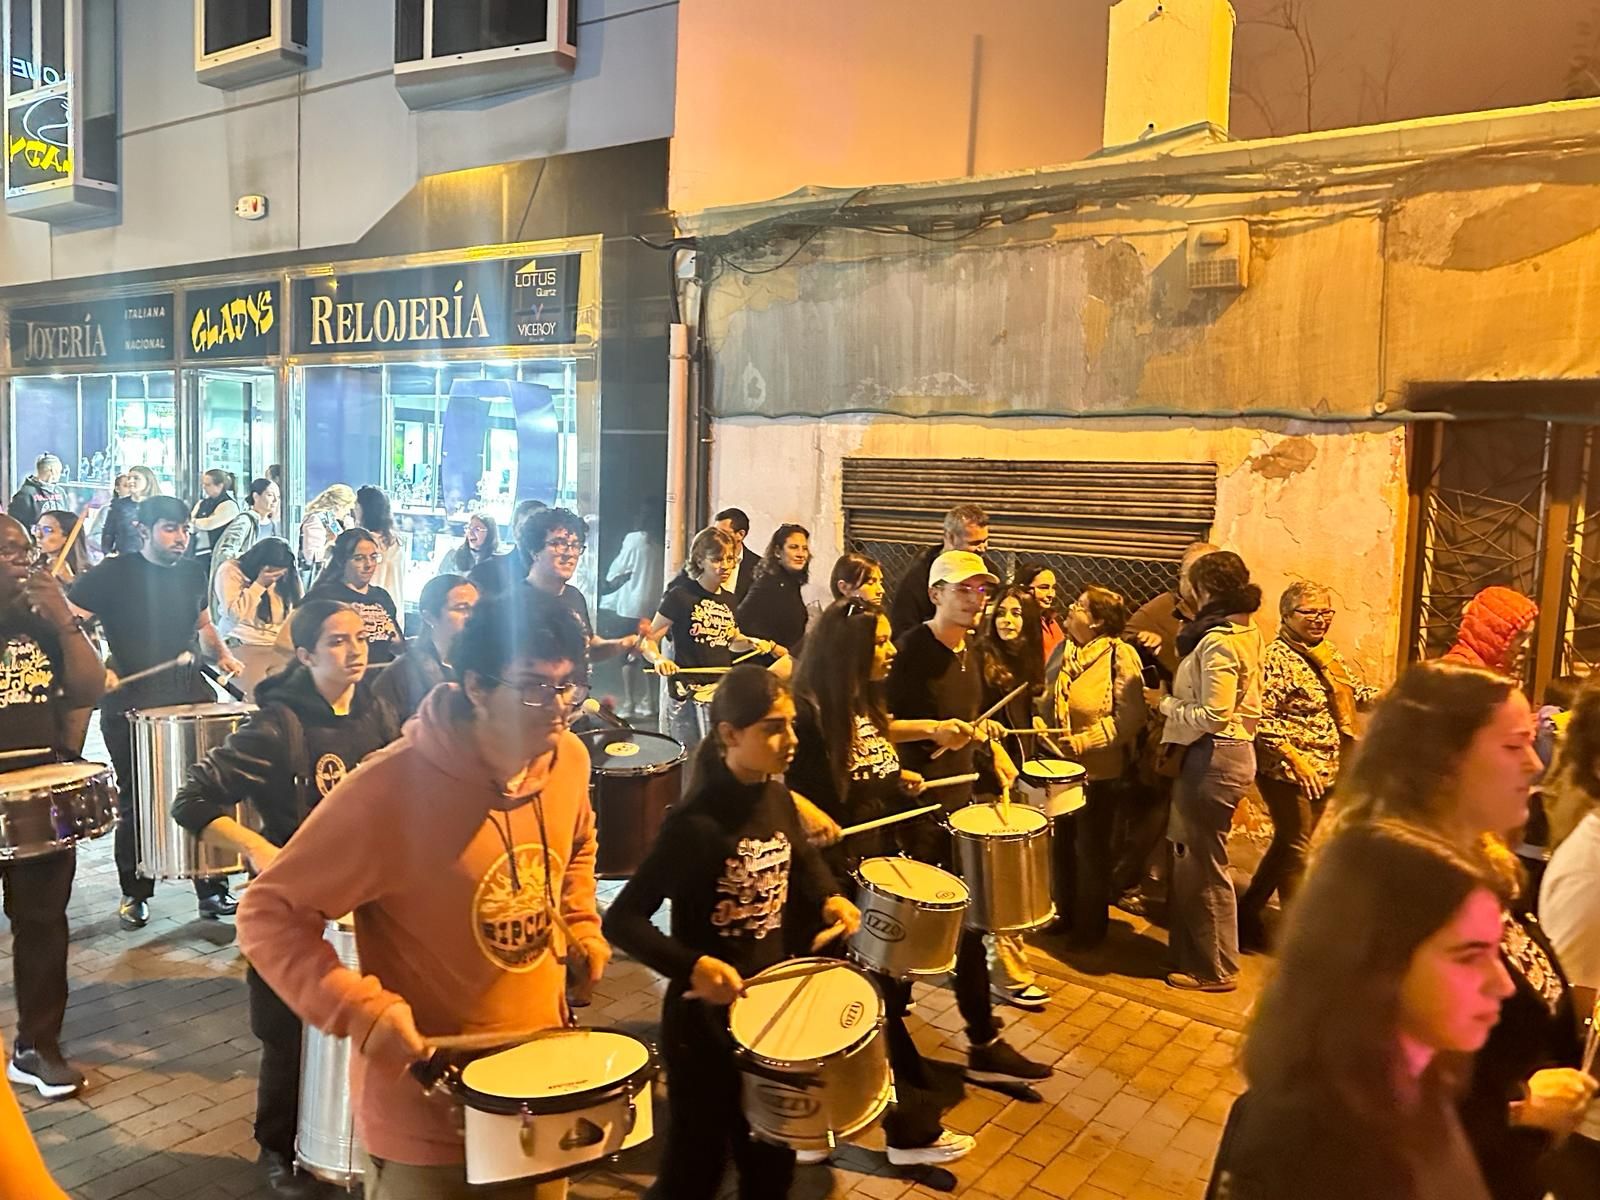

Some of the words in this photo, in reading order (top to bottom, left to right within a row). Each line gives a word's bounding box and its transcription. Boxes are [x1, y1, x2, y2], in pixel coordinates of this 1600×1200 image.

[515, 272, 556, 288] LOTUS
[124, 306, 166, 320] ITALIANA
[310, 279, 490, 345] RELOJERÍA
[191, 290, 274, 353] GLADYS
[517, 321, 557, 337] VICEROY
[24, 313, 108, 361] JOYERÍA
[124, 337, 166, 351] NACIONAL
